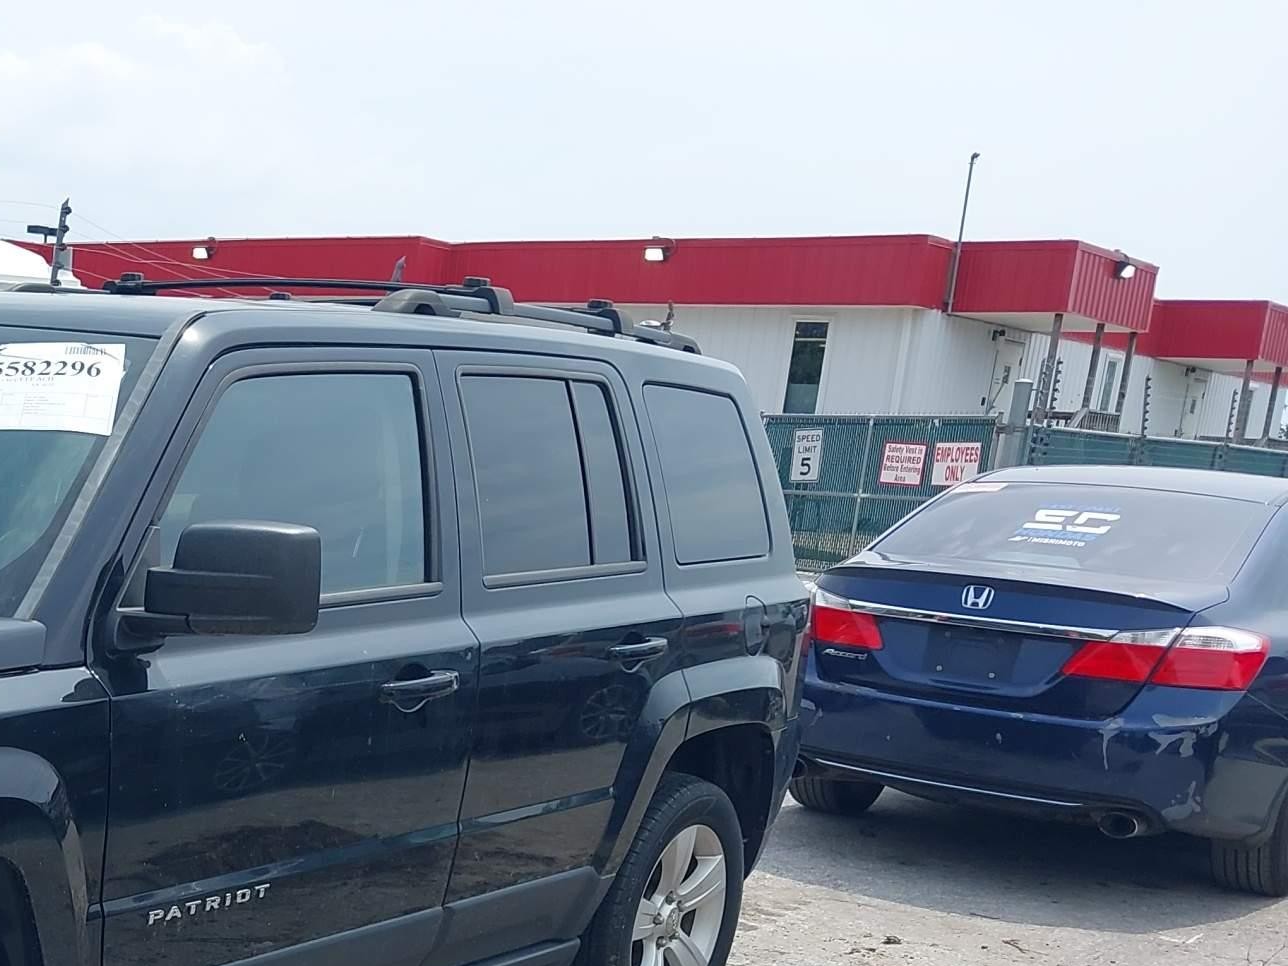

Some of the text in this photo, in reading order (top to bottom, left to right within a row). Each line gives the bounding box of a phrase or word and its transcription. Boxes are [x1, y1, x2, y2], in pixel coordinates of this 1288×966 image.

[796, 434, 821, 443] SPEED
[797, 445, 817, 454] LIMIT
[887, 445, 904, 454] Safety
[905, 445, 917, 454] Vest
[935, 446, 979, 463] EMPLOYEES
[885, 455, 922, 465] REQUIRED
[799, 457, 811, 476] 5
[883, 464, 921, 475] Before Entering
[894, 474, 906, 482] Area
[944, 465, 966, 482] ONLY
[823, 648, 868, 661] Accord
[147, 883, 271, 926] PATRIOT
